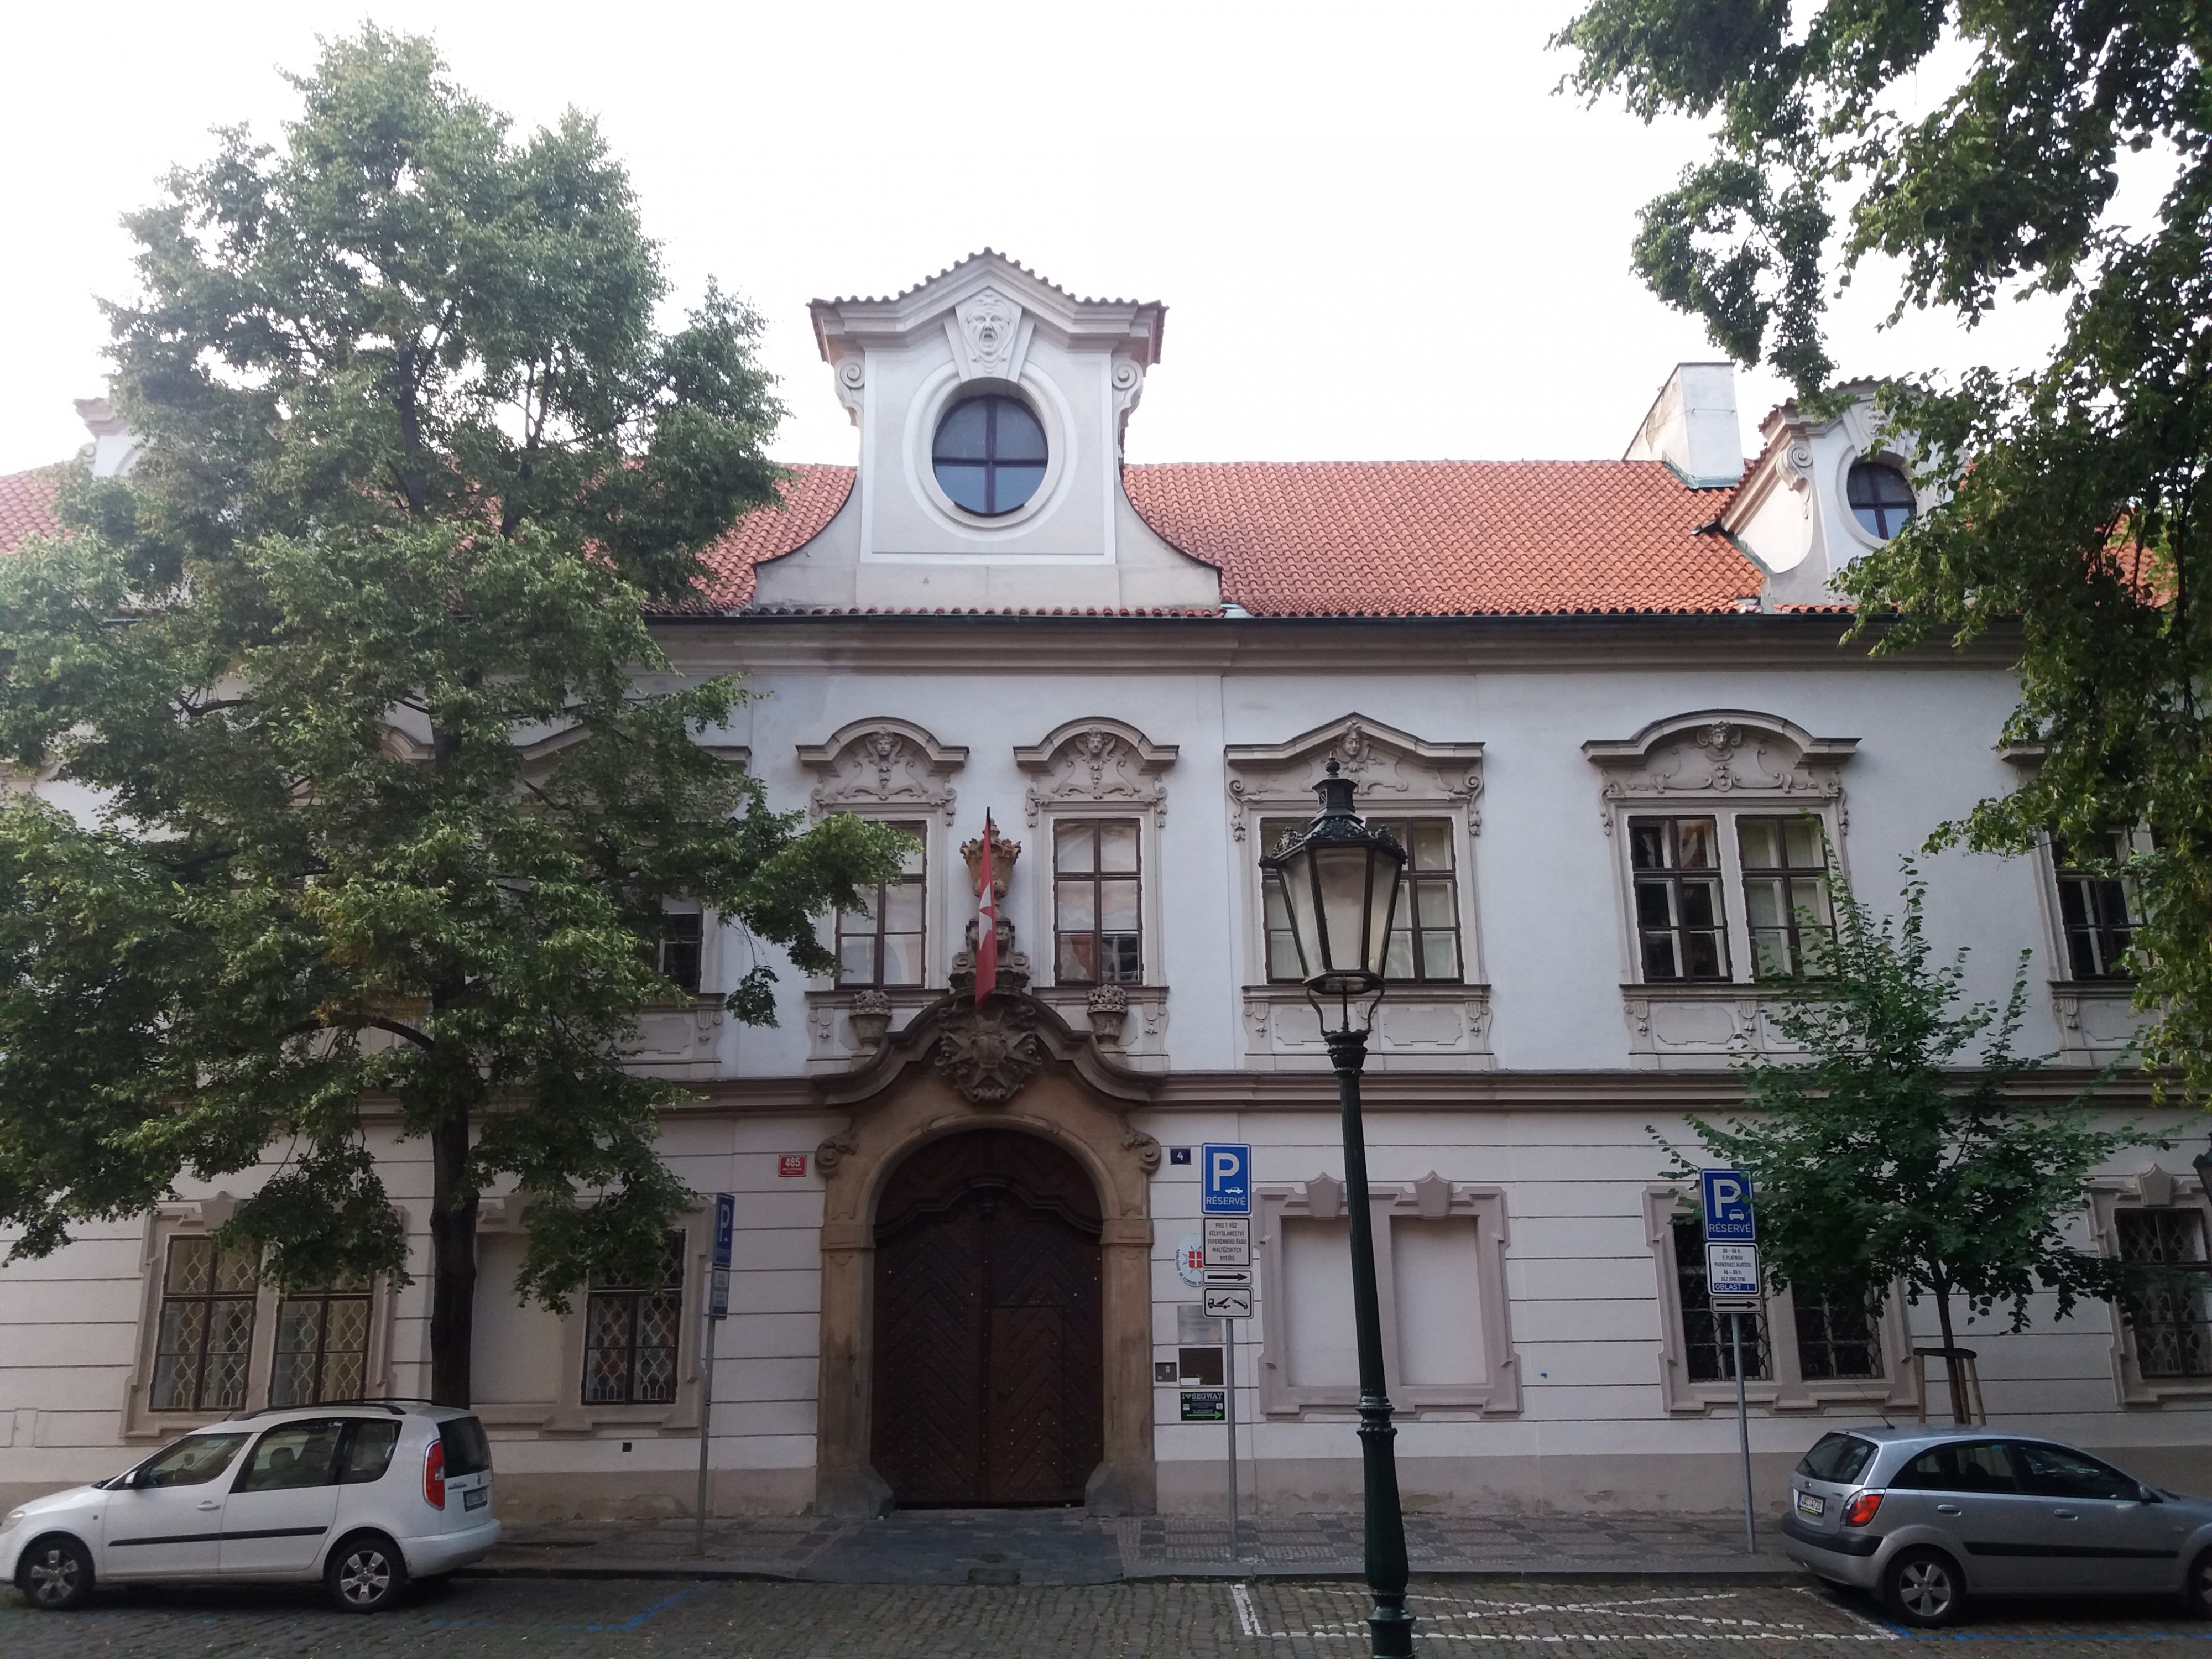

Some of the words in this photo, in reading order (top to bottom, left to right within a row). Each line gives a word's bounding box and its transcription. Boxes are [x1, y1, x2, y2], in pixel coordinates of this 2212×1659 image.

[1177, 1151, 1184, 1161] 4
[785, 1157, 801, 1167] 485
[1213, 1152, 1240, 1191] P
[1206, 1195, 1246, 1206] RÉSERVÉ
[1713, 1178, 1741, 1218] P
[719, 1204, 730, 1242] P
[1709, 1222, 1751, 1233] RÉSERVÉ
